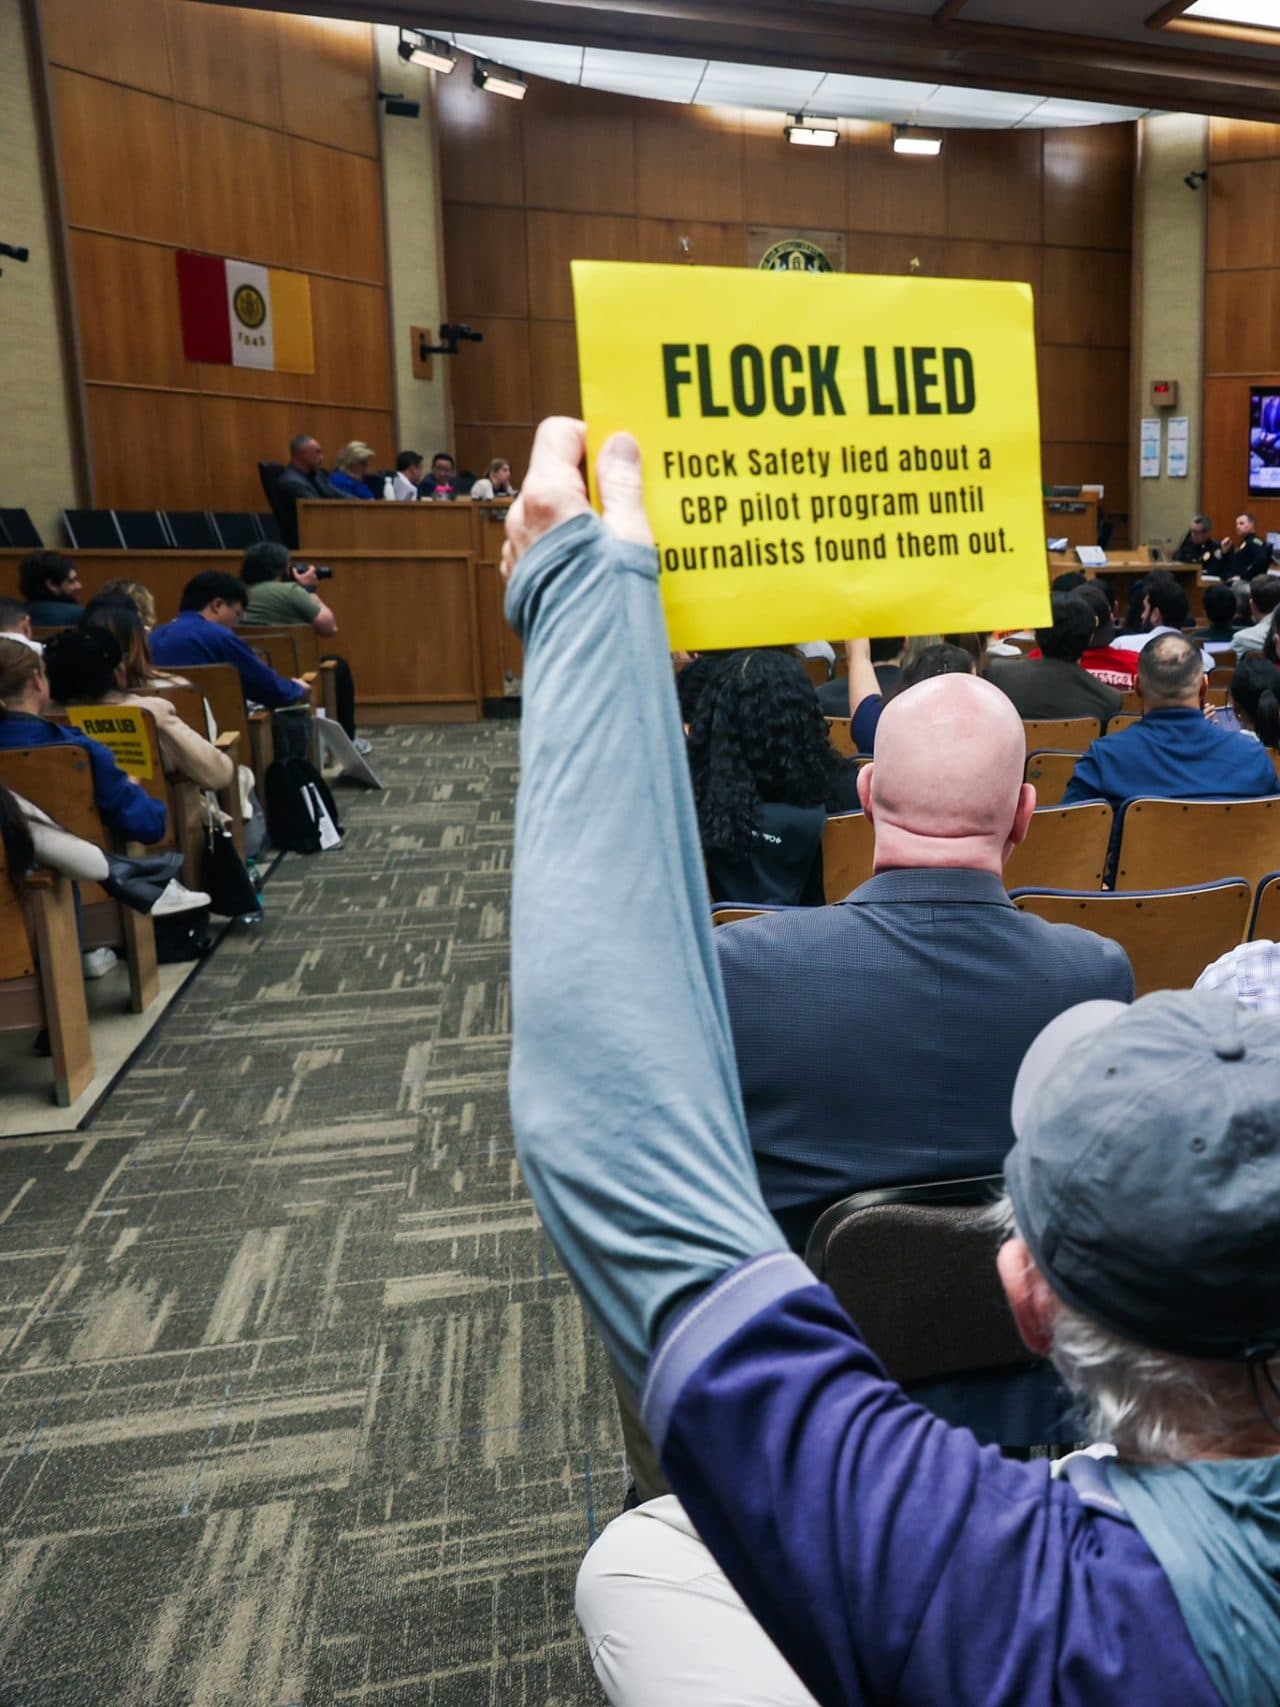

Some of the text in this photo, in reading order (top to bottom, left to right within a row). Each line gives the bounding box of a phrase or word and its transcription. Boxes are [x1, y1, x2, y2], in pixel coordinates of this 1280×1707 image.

[662, 343, 976, 418] FLOCK LIED
[663, 444, 991, 479] Flock Safety lied about a
[681, 486, 984, 527] CBP pilot program until
[815, 533, 887, 563] found
[896, 531, 959, 559] them
[968, 527, 1014, 555] out.
